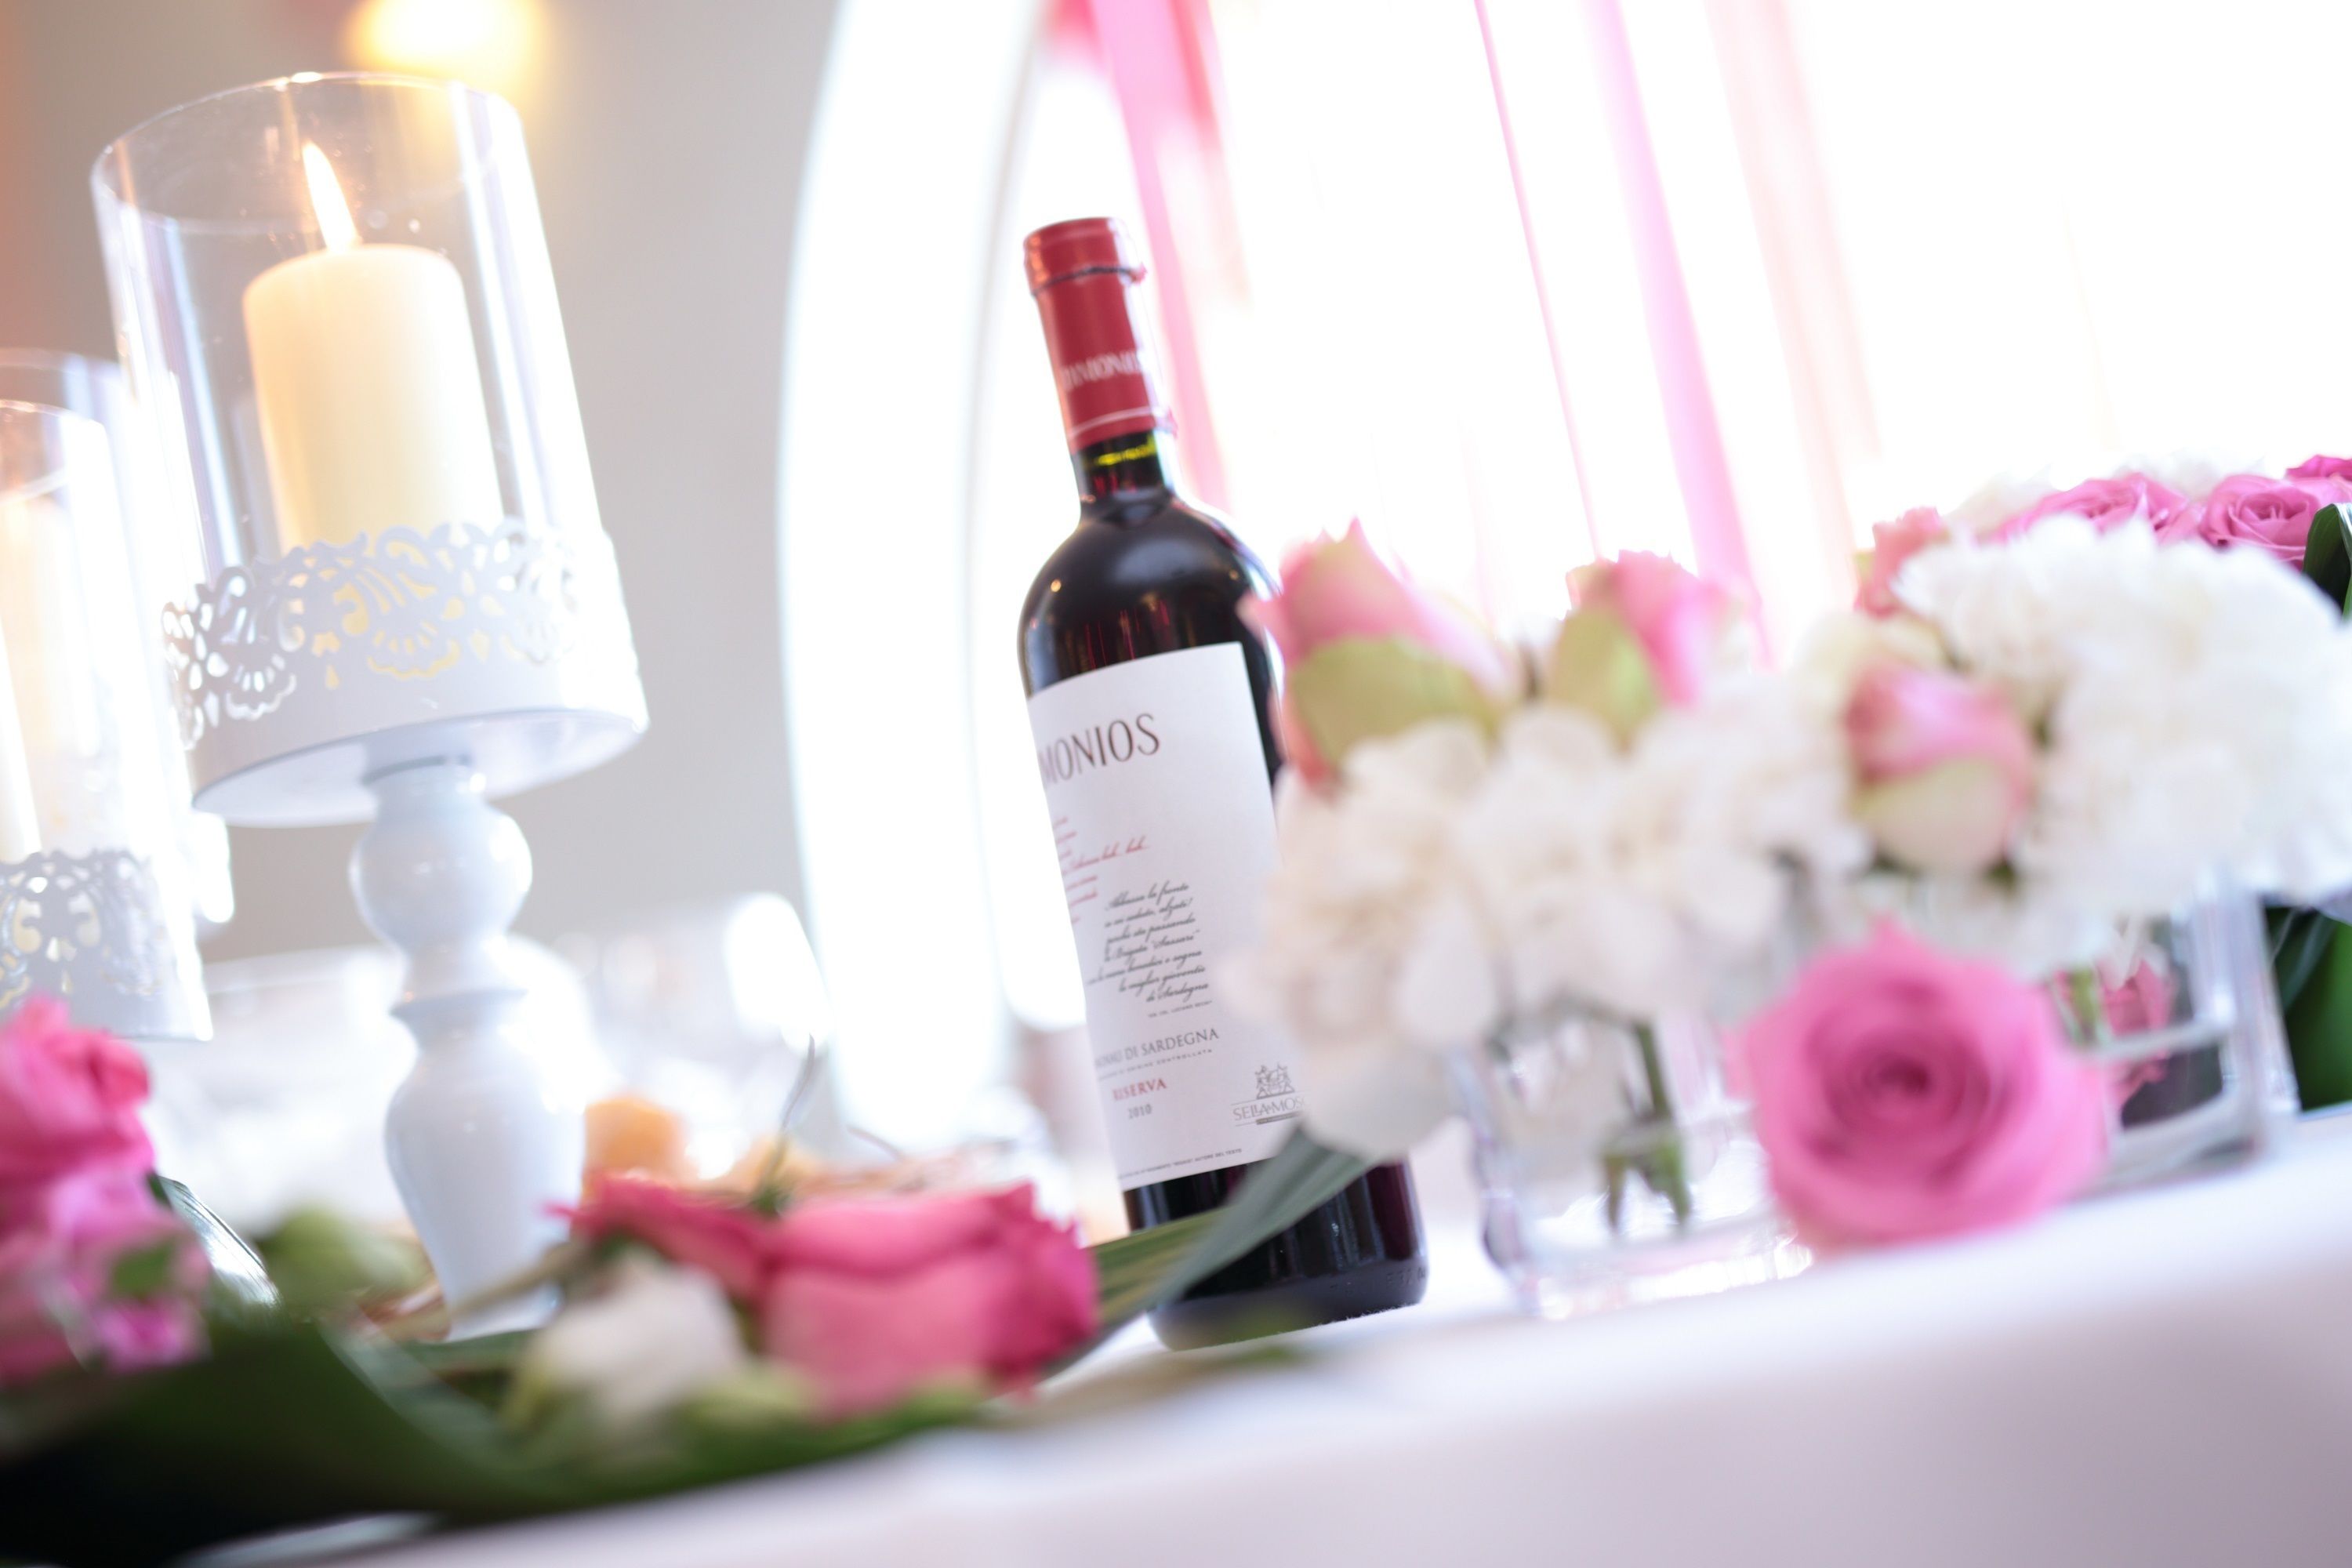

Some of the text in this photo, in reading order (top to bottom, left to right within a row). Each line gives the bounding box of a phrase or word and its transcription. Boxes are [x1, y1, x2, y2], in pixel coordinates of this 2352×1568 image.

[1124, 1045, 1138, 1060] DI
[1141, 1028, 1219, 1056] SARDEGNA
[1112, 1077, 1167, 1102] RISERVA
[1127, 1104, 1153, 1120] 2010
